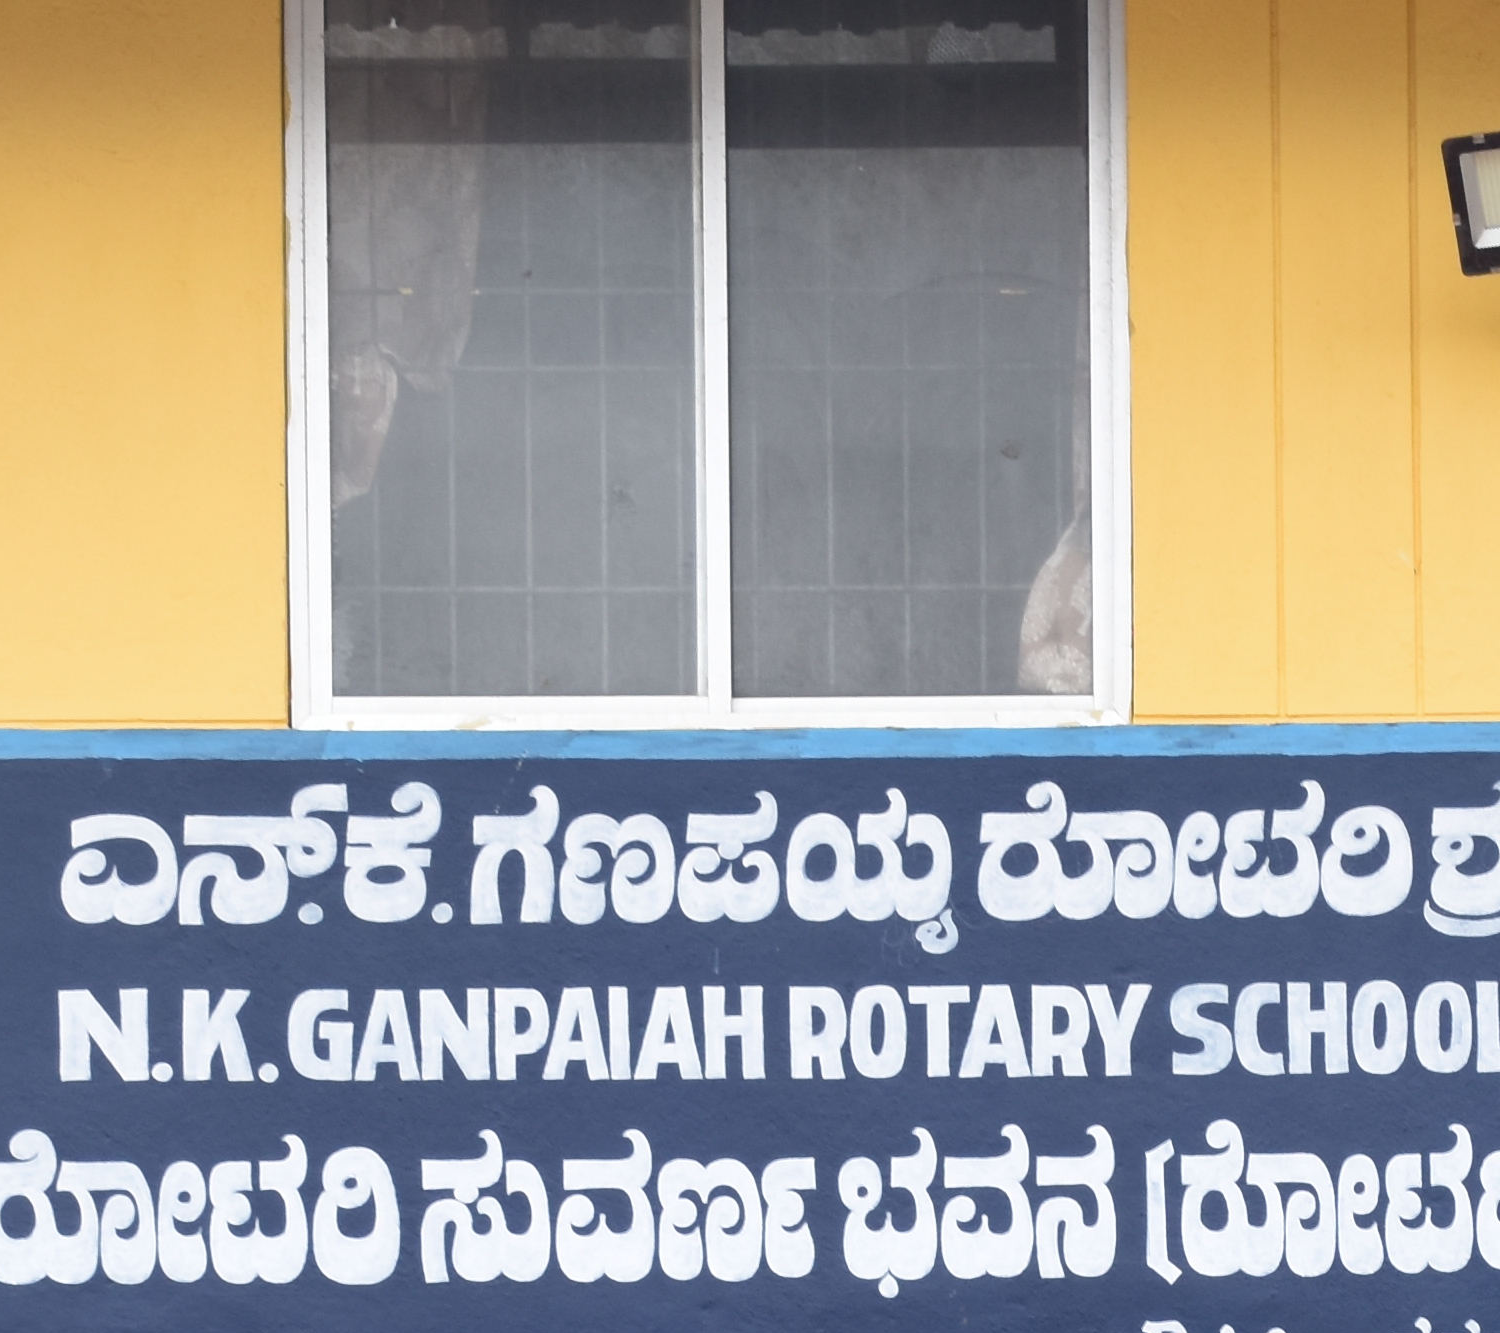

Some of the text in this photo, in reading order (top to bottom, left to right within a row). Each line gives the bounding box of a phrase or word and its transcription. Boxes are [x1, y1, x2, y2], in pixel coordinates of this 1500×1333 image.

[468, 783, 960, 956] ಗಣಪಯ್ಯ
[976, 778, 1415, 923] ರೋಟರಿ
[787, 982, 1154, 1081] ROTARY
[419, 1127, 818, 1285] ಸುವರ್ಣ
[836, 1122, 1118, 1300] ಭವನ
